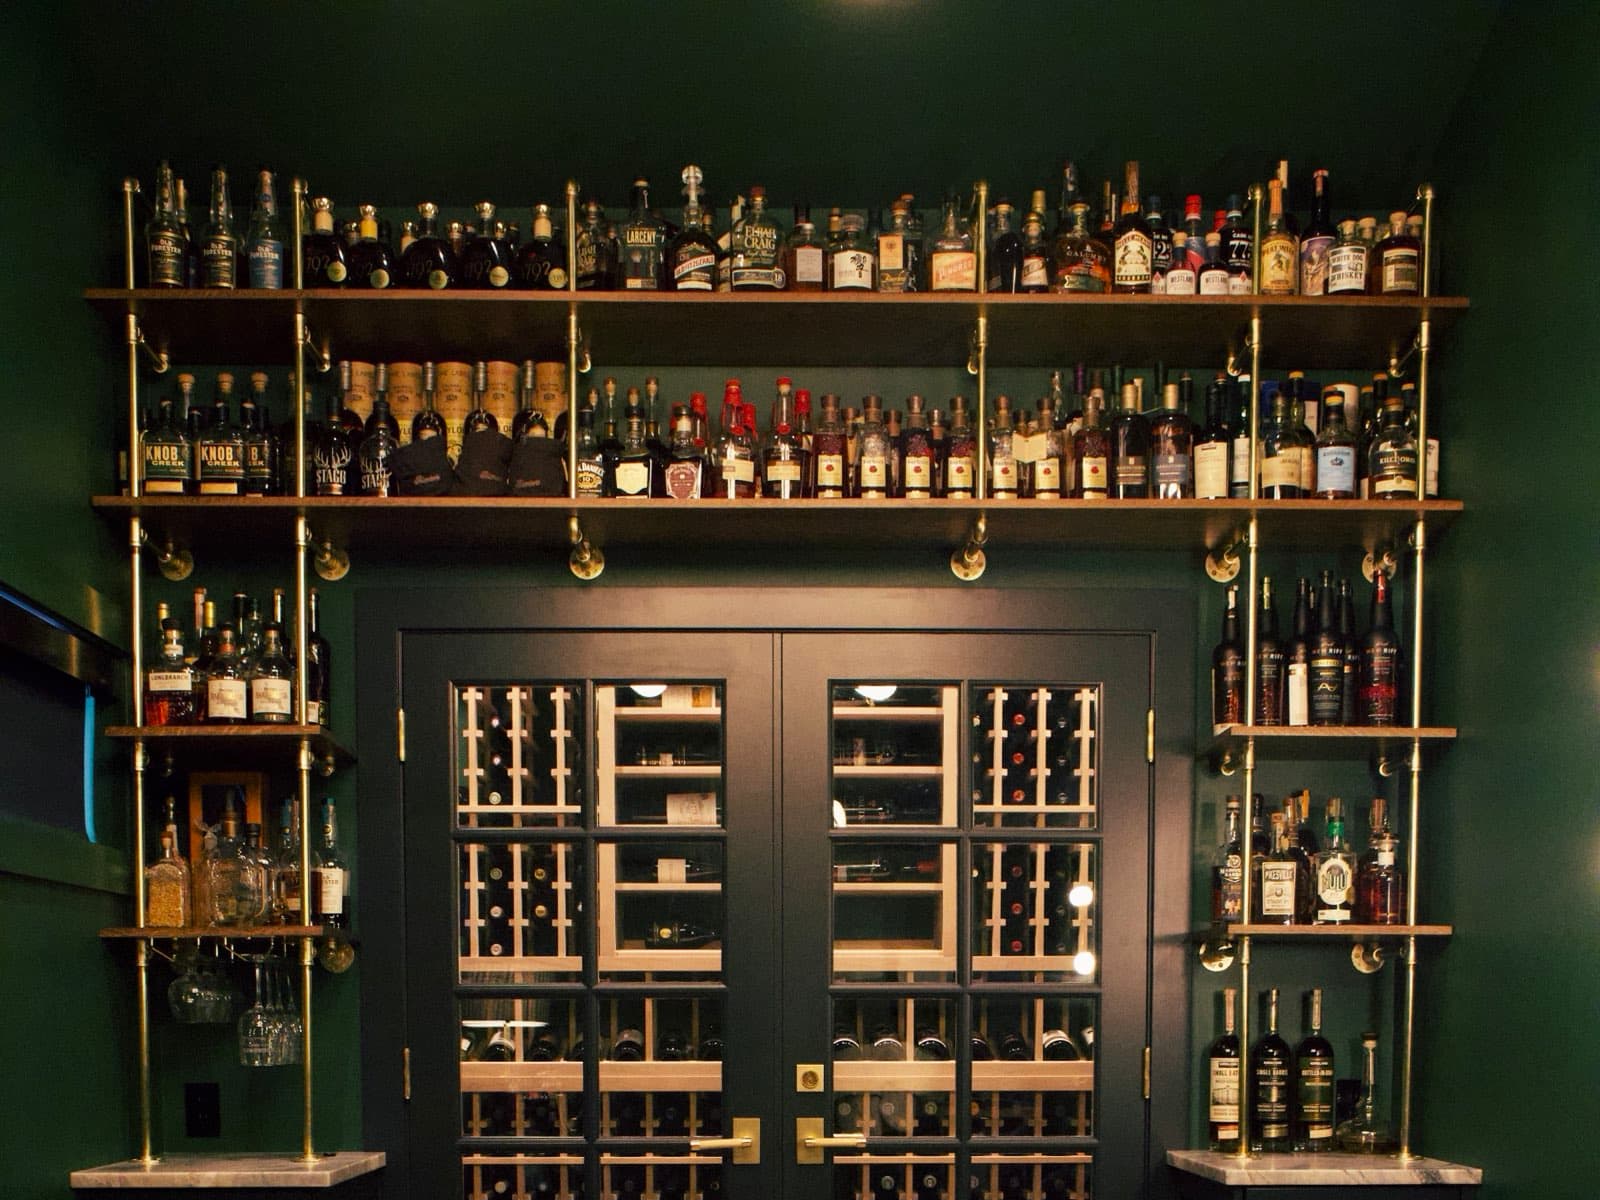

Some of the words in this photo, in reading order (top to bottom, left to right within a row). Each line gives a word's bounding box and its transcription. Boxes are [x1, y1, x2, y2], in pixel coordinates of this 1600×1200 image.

[626, 230, 656, 244] LARCENY
[745, 225, 777, 239] ELIJAH
[744, 237, 776, 250] CRAIG
[1331, 271, 1363, 283] WHISKEY
[145, 445, 179, 461] KNOB
[201, 445, 233, 461] KNOB
[150, 673, 189, 682] LONGBRANCH
